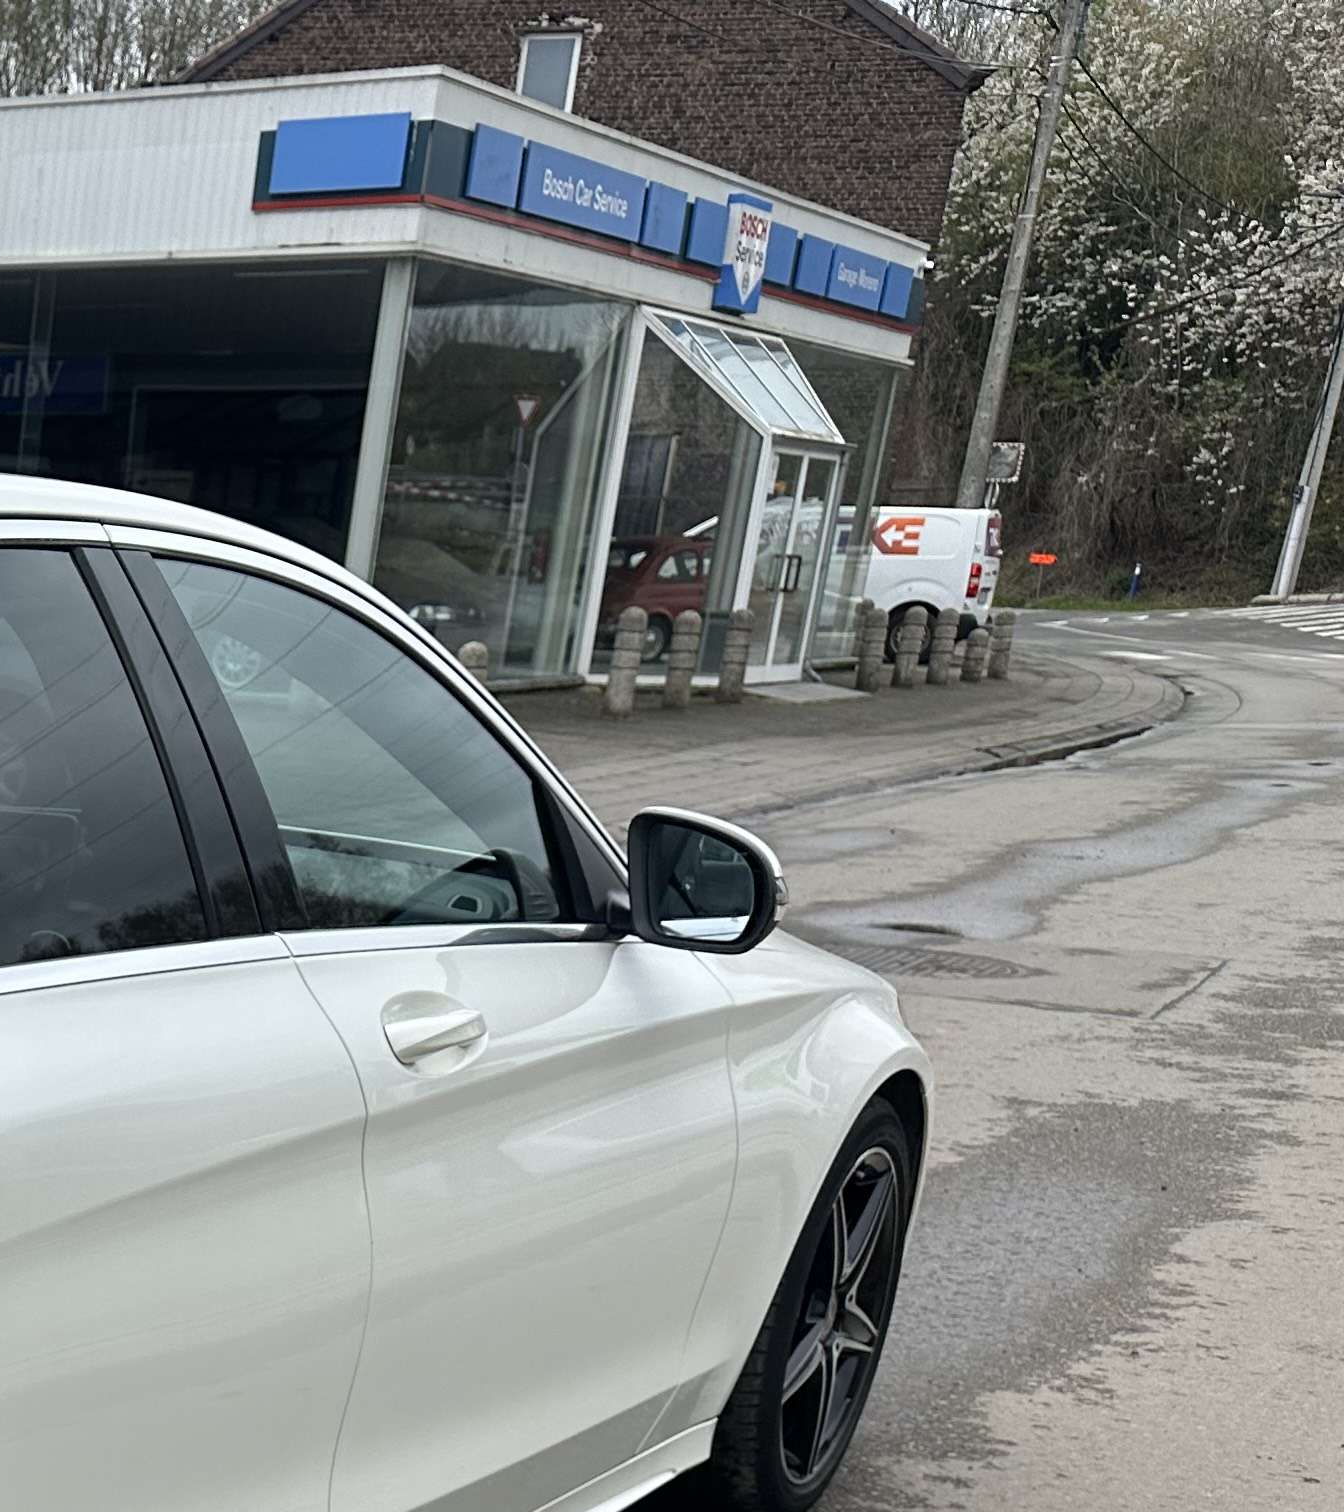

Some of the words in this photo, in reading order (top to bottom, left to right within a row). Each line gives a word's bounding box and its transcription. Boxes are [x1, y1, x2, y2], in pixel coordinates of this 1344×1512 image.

[542, 168, 574, 202] Bosch
[575, 178, 594, 208] Car
[594, 184, 629, 219] Service
[739, 211, 769, 239] BOSCH
[735, 243, 765, 269] Service
